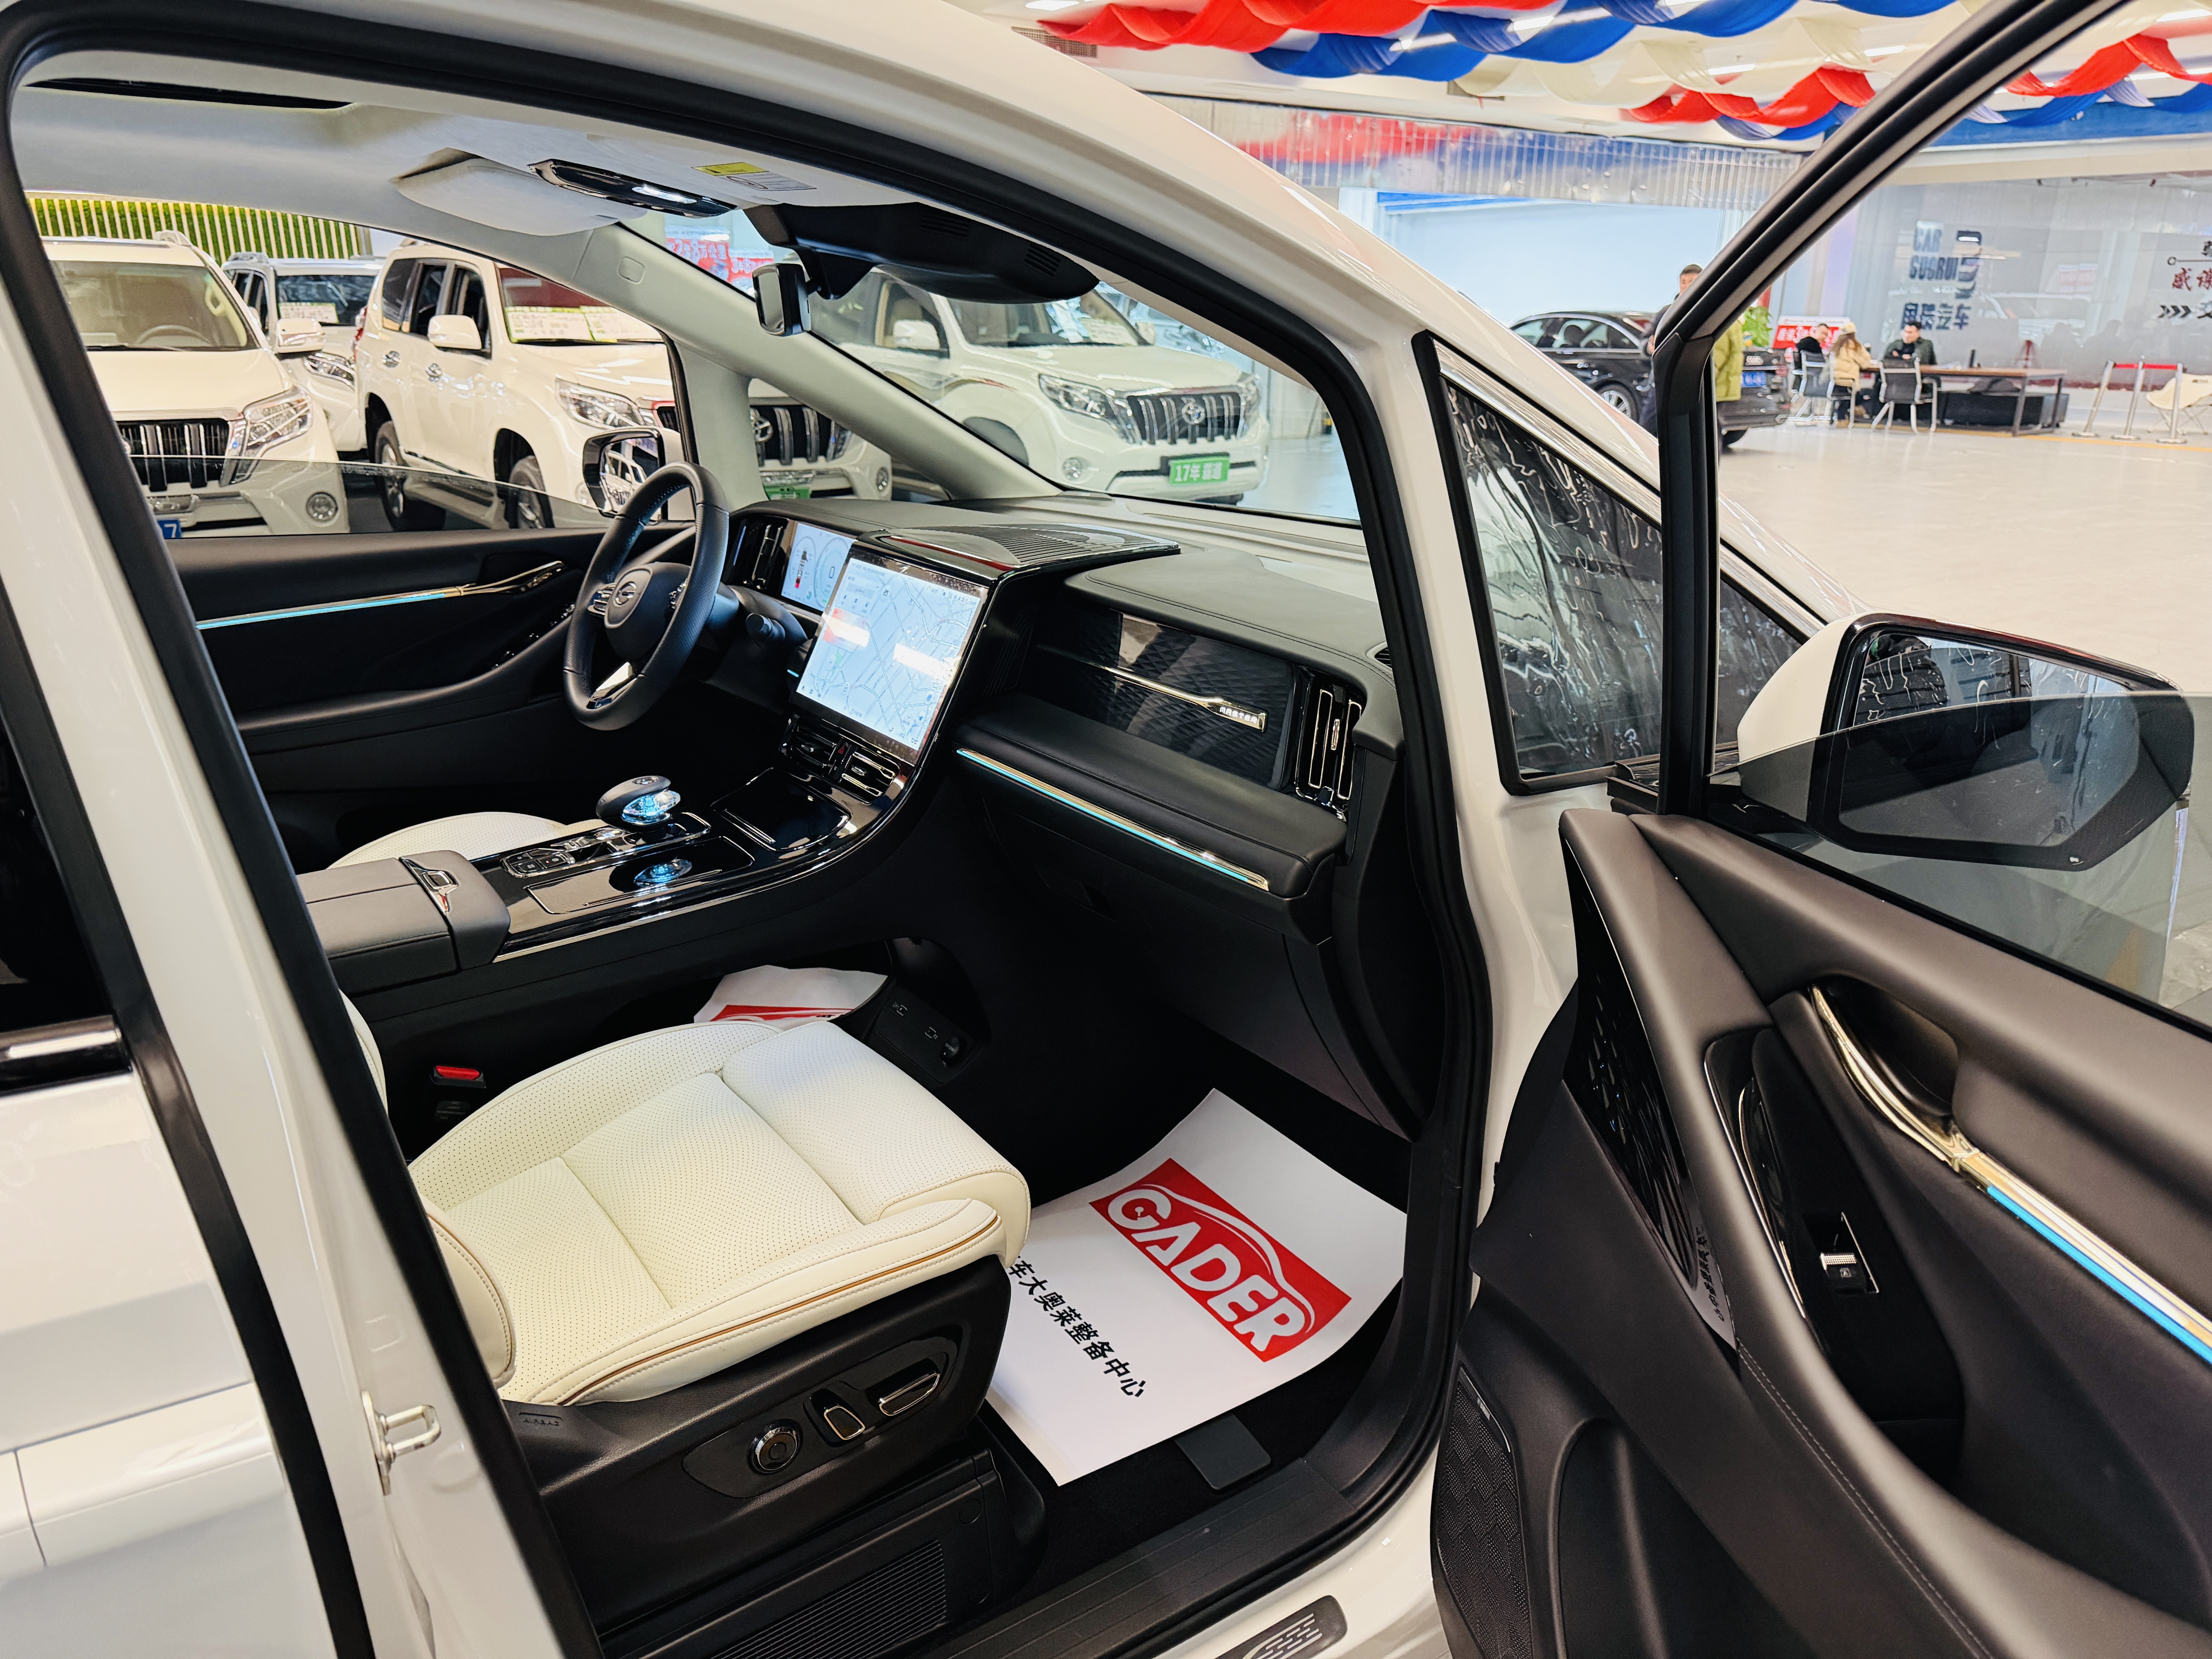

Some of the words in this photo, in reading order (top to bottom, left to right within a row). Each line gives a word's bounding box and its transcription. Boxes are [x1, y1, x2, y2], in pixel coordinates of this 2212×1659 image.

[1219, 706, 1258, 724] MASTER
[1009, 1256, 1146, 1398] 车大奥莱整备中心
[1108, 1188, 1305, 1352] GADER
